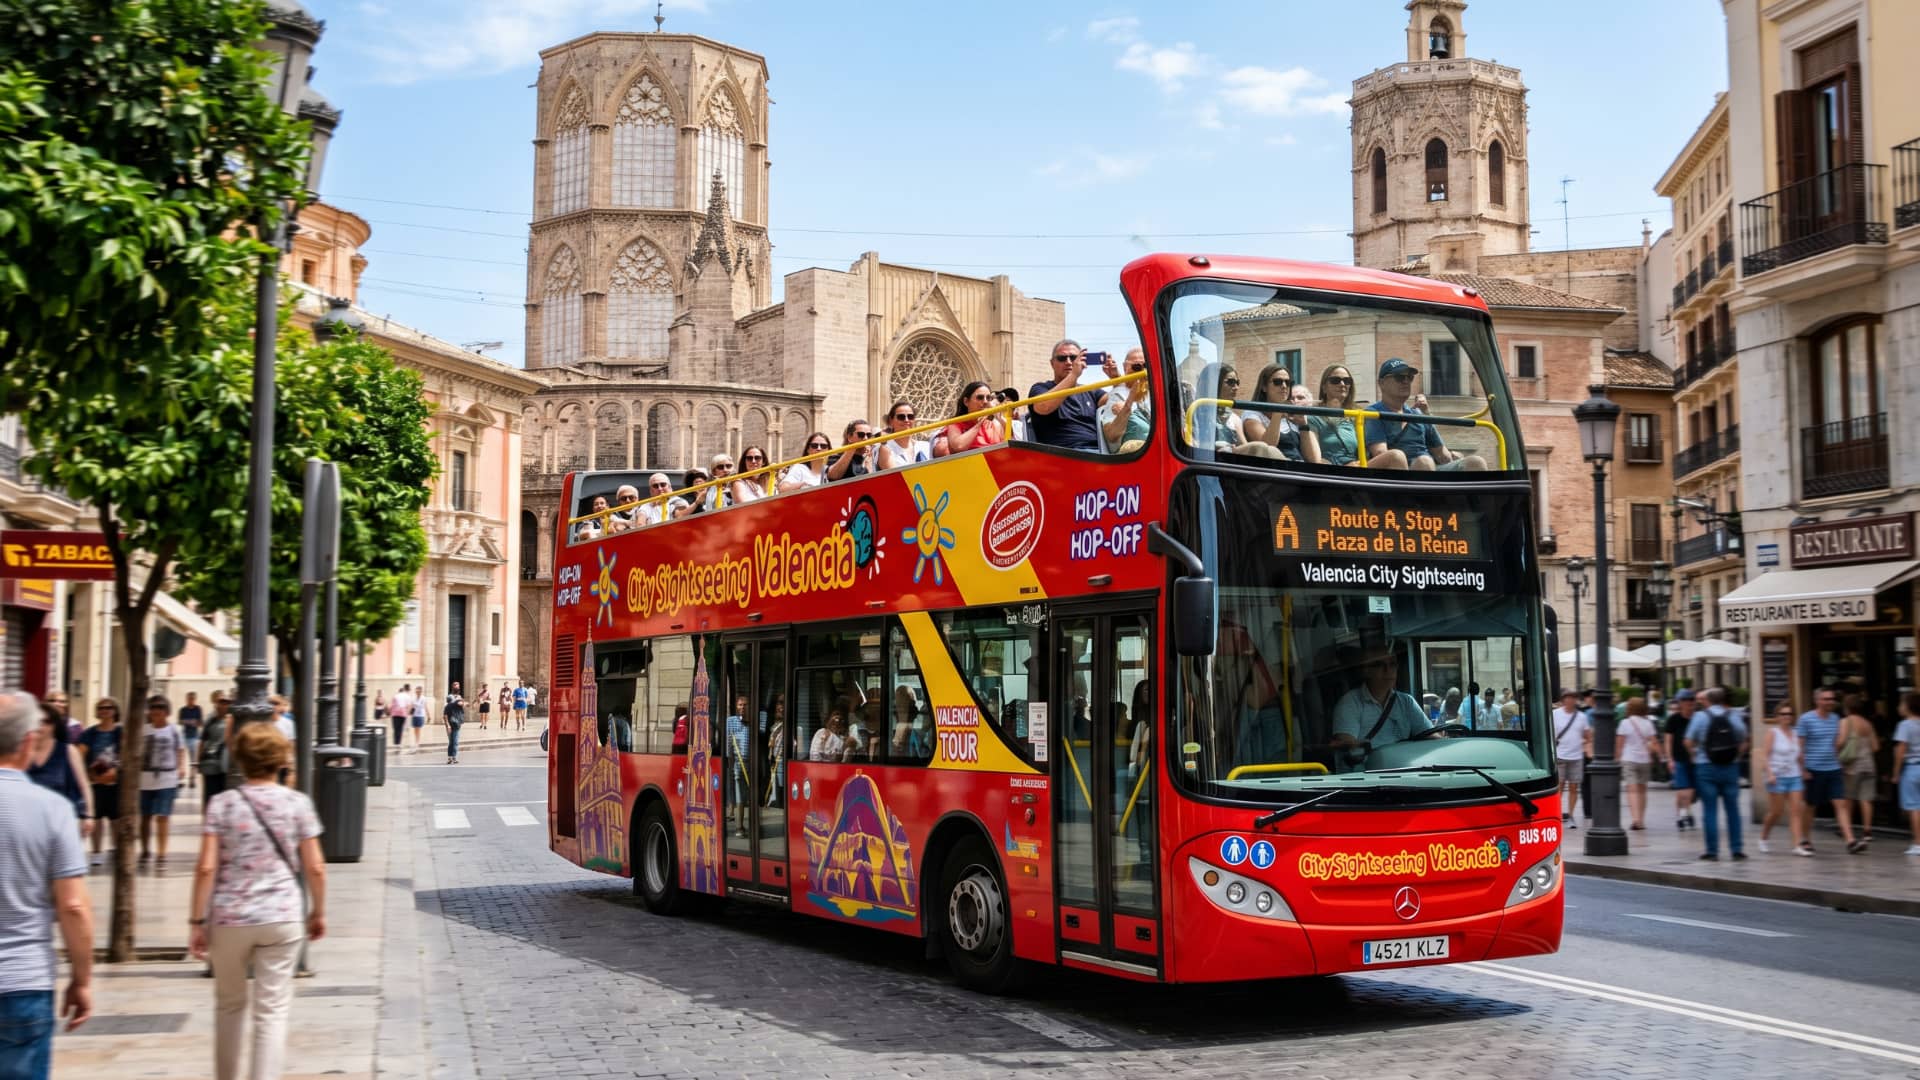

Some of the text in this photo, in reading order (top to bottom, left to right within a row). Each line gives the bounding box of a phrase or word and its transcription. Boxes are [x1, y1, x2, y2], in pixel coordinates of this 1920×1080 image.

[1074, 485, 1141, 521] HOP-ON
[1275, 505, 1299, 549] A
[1330, 507, 1458, 535] Route A, Stop 4
[1071, 523, 1142, 560] HOP-OFF
[1317, 529, 1469, 554] Plaza de la Reina
[1793, 522, 1905, 558] RESTAURANTE
[754, 522, 856, 598] Valencia
[1301, 562, 1485, 591] Valencia City Sightseeing
[1726, 600, 1866, 622] RESTAURANTE EL SIGLO
[936, 706, 979, 728] VALENCIA
[939, 731, 978, 763] TOUR
[1519, 826, 1558, 844] BUS 108
[1429, 841, 1501, 871] Valencia
[1374, 939, 1445, 960] 4521 KLZ
